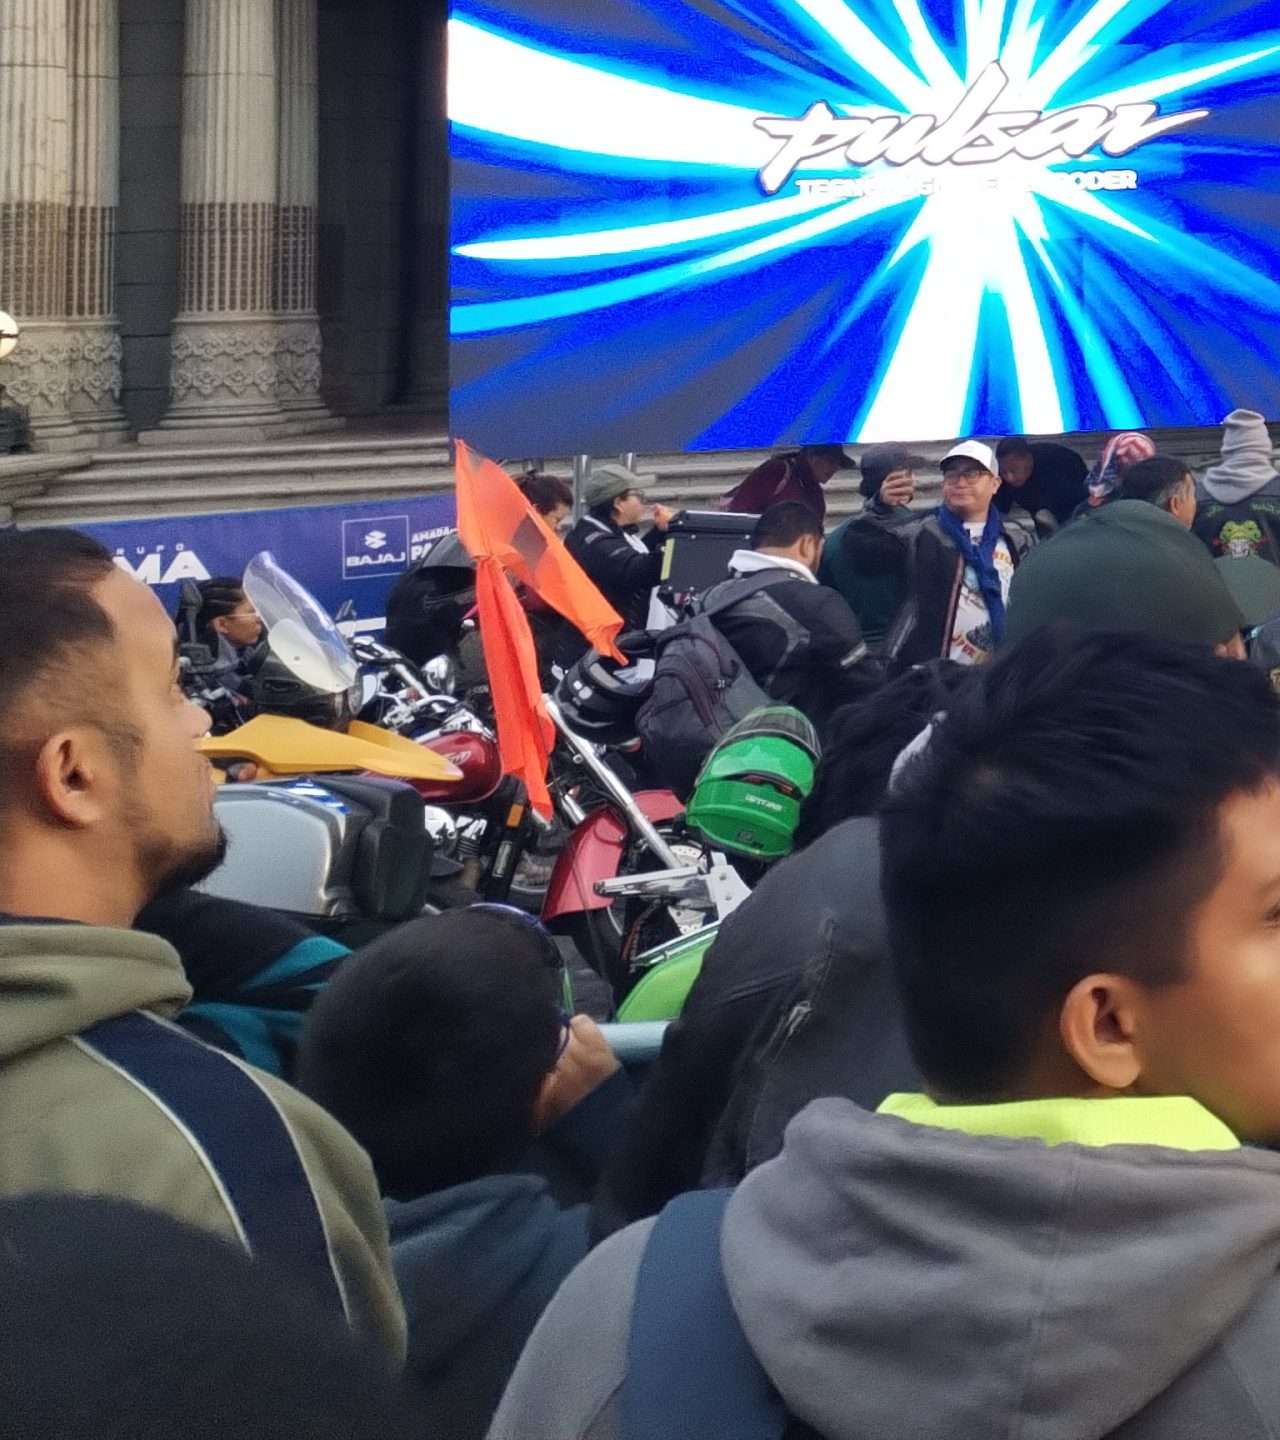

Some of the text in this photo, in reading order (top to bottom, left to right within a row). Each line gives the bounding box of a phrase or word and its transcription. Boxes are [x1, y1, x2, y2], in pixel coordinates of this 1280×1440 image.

[116, 543, 184, 555] RUPO
[112, 550, 212, 584] MA
[346, 551, 406, 567] BAJAJ
